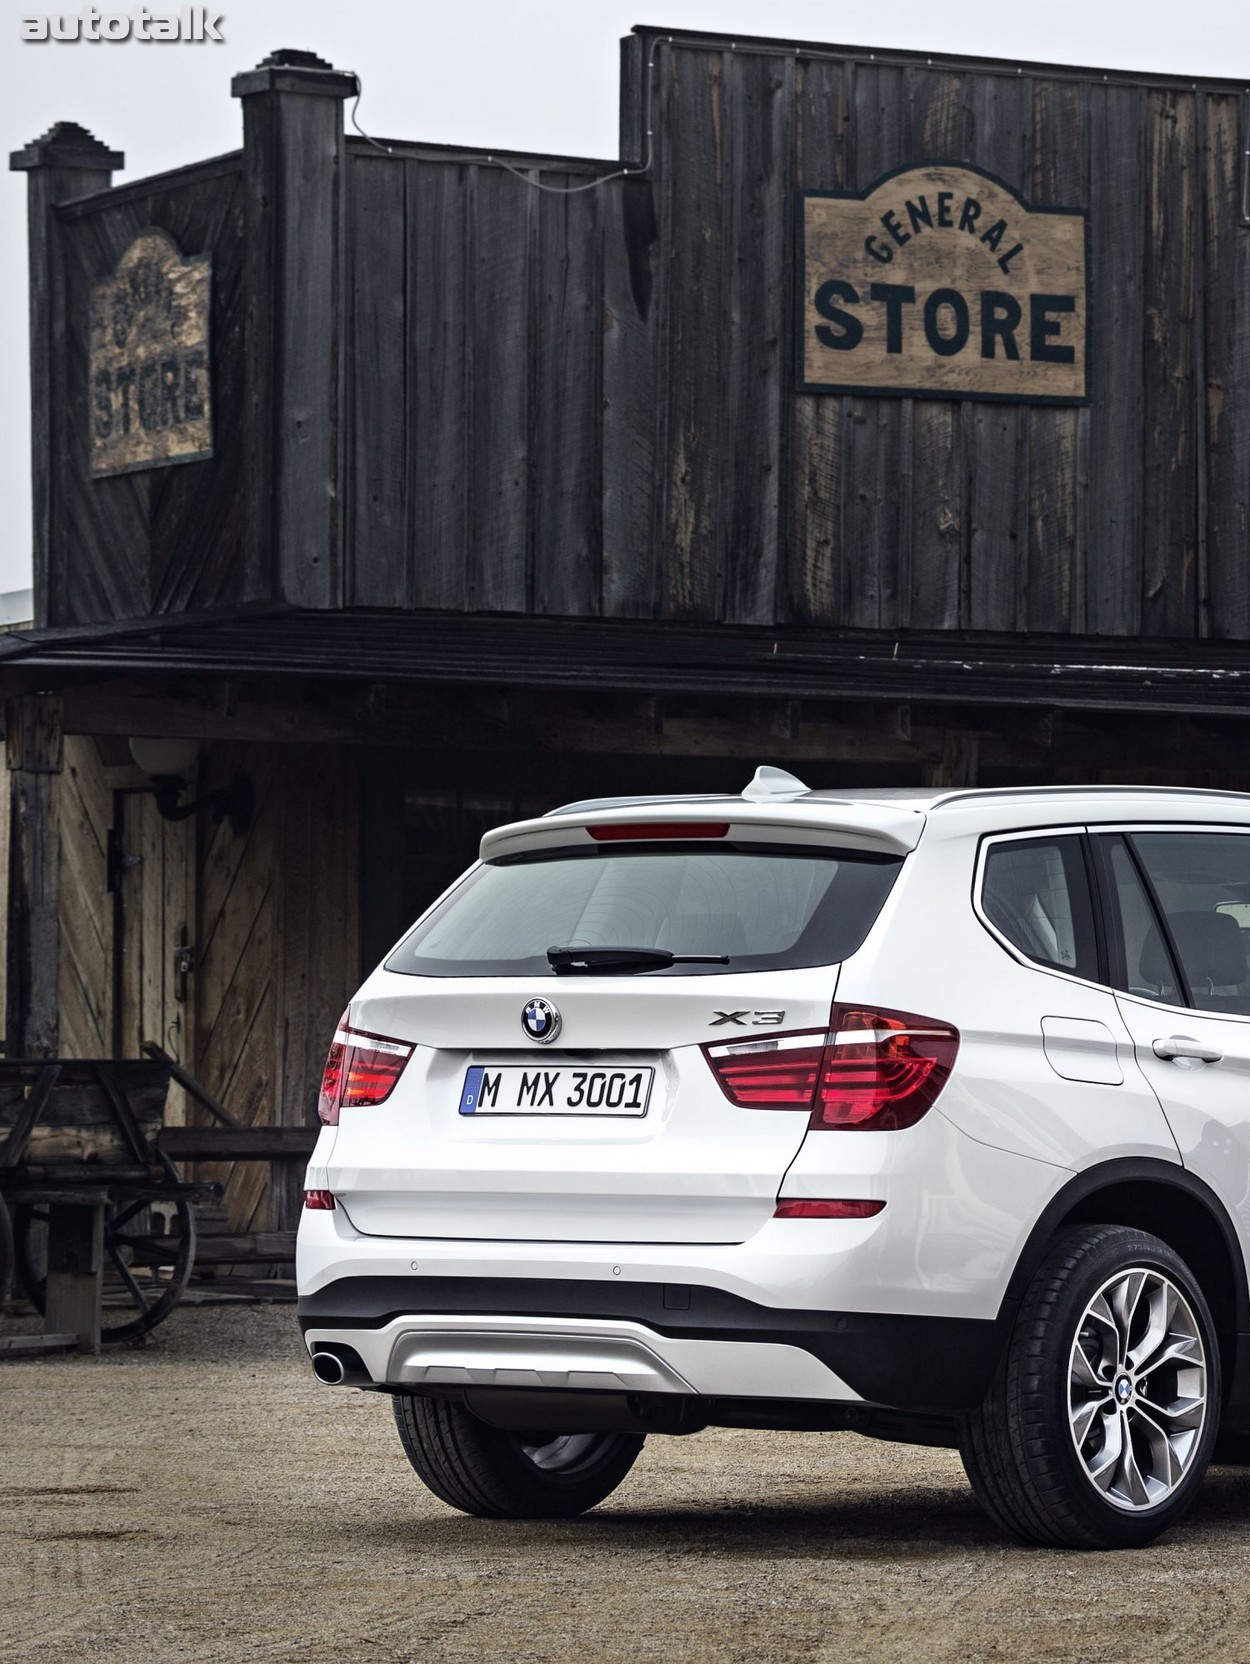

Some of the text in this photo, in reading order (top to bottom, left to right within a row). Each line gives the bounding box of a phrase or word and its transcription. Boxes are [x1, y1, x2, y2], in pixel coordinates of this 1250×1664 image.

[864, 192, 1024, 275] GENERAL
[814, 280, 1075, 364] STORE
[708, 1010, 786, 1026] X3
[466, 1094, 474, 1105] D
[477, 1072, 643, 1109] M MX 3001
